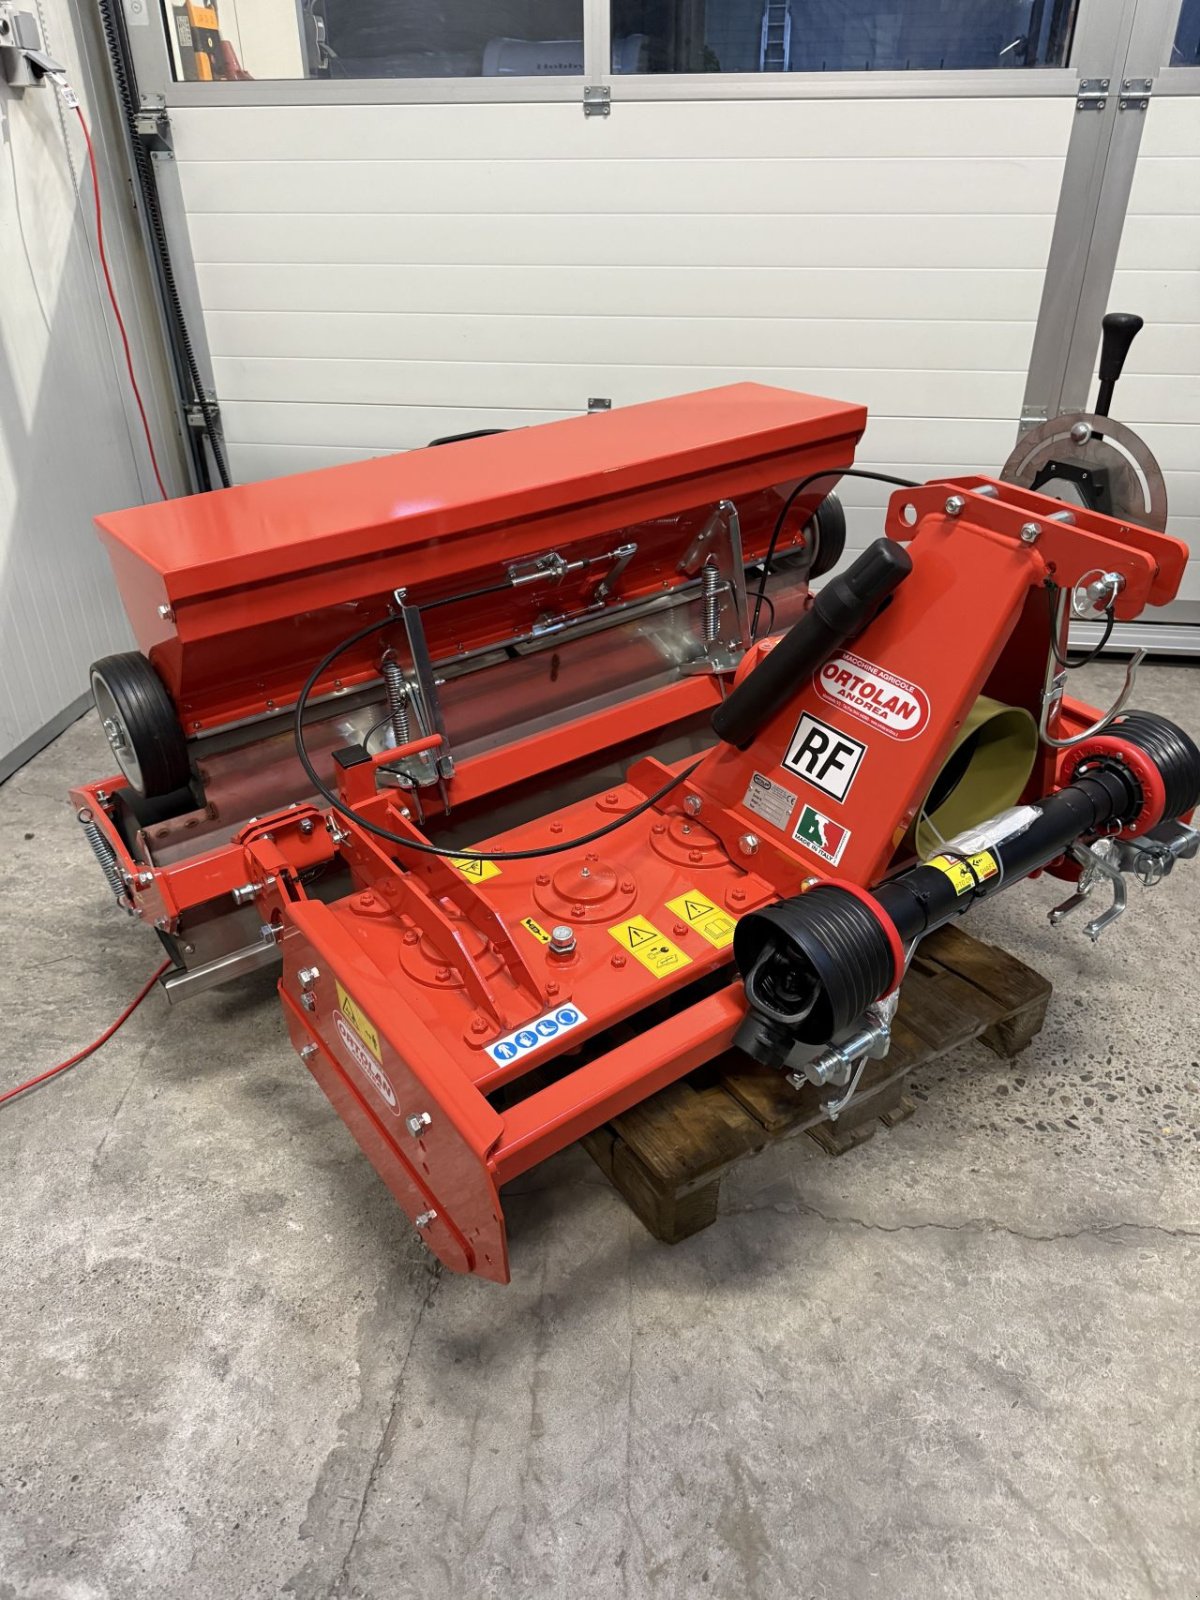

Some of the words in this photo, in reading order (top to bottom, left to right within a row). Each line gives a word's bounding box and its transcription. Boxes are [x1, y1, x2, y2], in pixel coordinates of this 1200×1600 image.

[822, 663, 917, 720] ORTOLAN
[842, 653, 878, 675] MACCHINE
[878, 672, 915, 693] AGRICOLE
[837, 689, 888, 720] ANDREA
[791, 727, 854, 780] RF
[794, 833, 811, 847] MADE
[818, 849, 834, 861] ITALY
